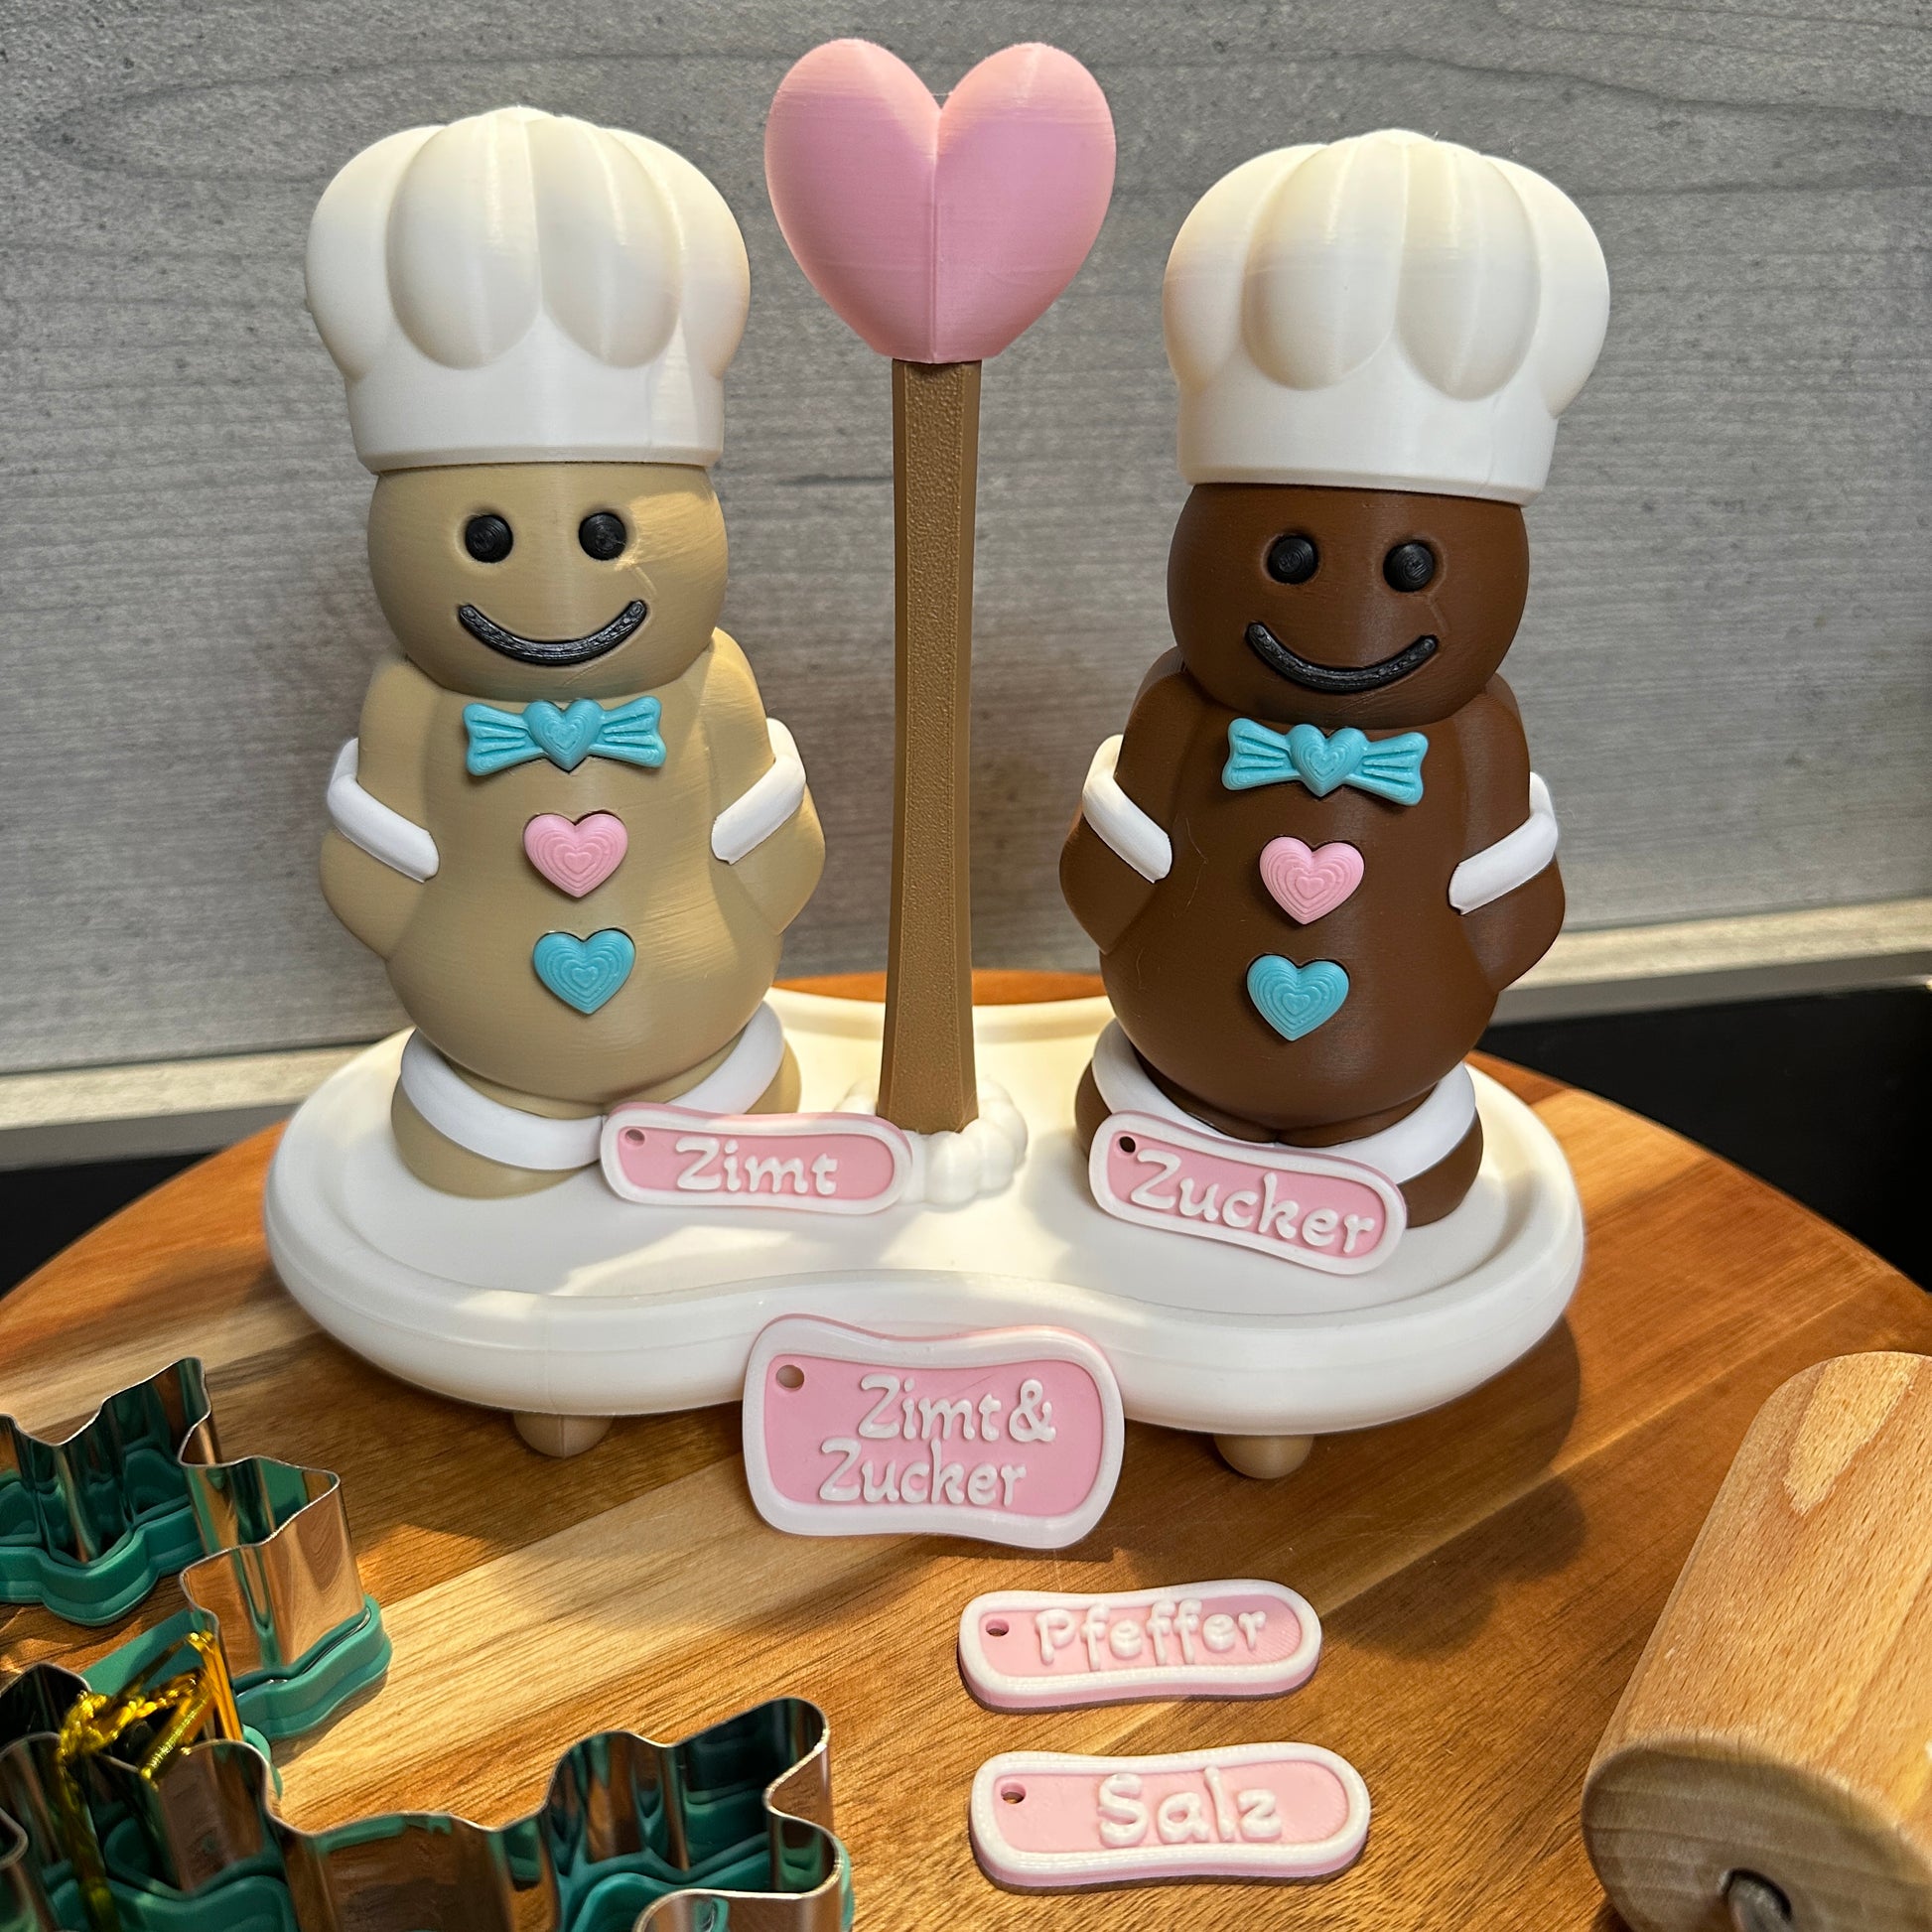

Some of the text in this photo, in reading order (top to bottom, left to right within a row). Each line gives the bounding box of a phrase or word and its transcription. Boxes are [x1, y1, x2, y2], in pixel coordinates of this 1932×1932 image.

[675, 1136, 838, 1195] Zimt
[1130, 1149, 1376, 1254] Zucker
[819, 1437, 1028, 1507] Zucker
[1035, 1598, 1267, 1672] Pfeffer
[1097, 1764, 1283, 1849] Salz
